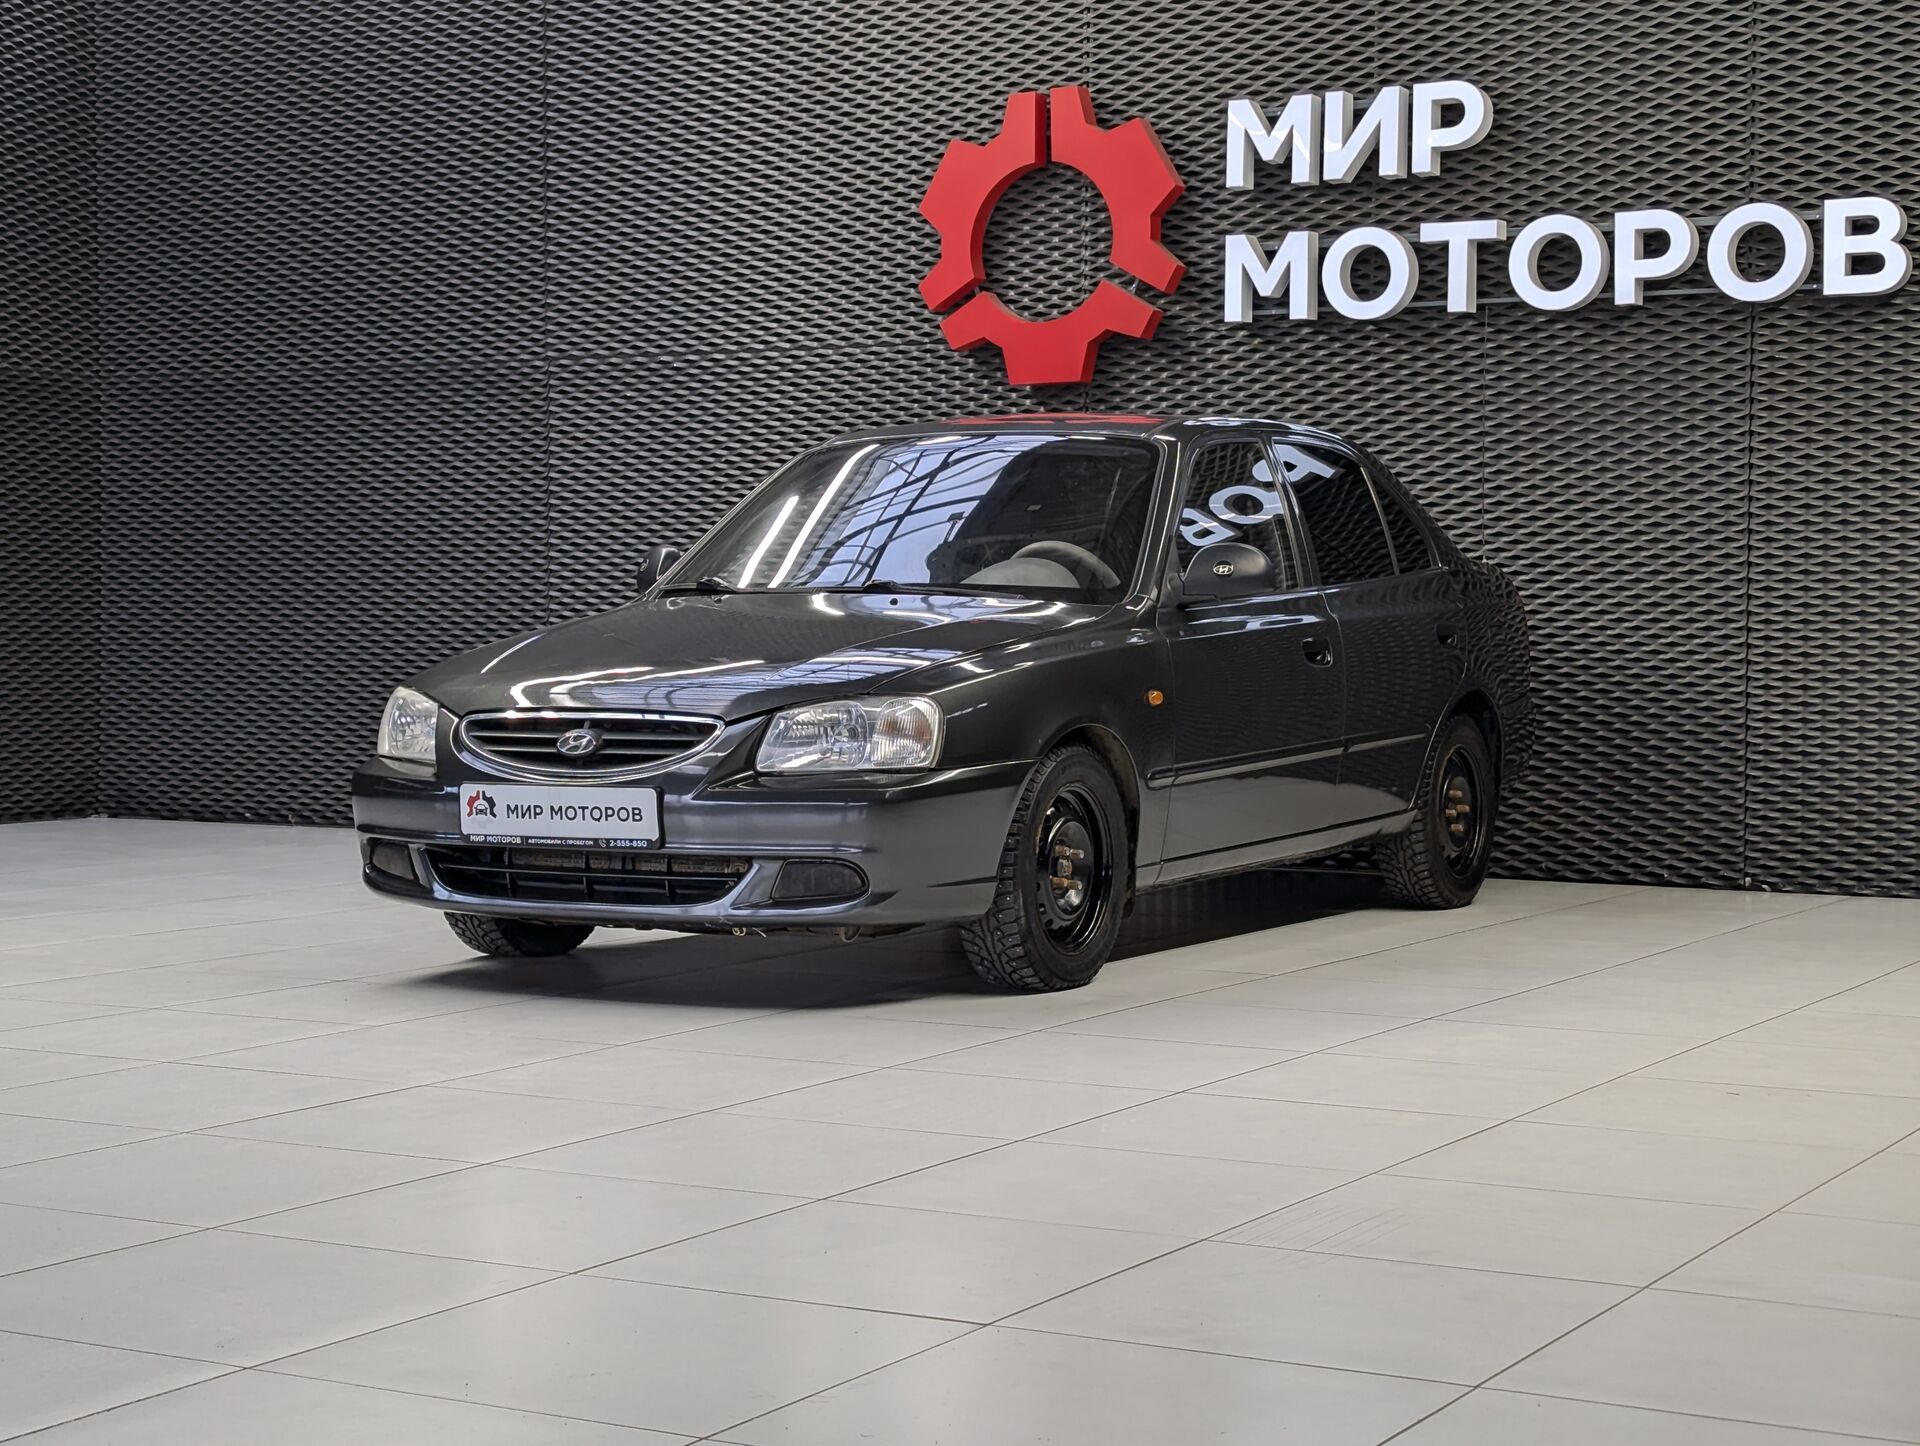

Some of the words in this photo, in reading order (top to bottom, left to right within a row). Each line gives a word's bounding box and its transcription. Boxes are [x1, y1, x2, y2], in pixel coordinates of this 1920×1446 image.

[1225, 80, 1493, 190] МИР
[1223, 196, 1911, 323] МОТОРОВ
[506, 803, 543, 820] МИР
[550, 805, 643, 822] МОТОРОВ
